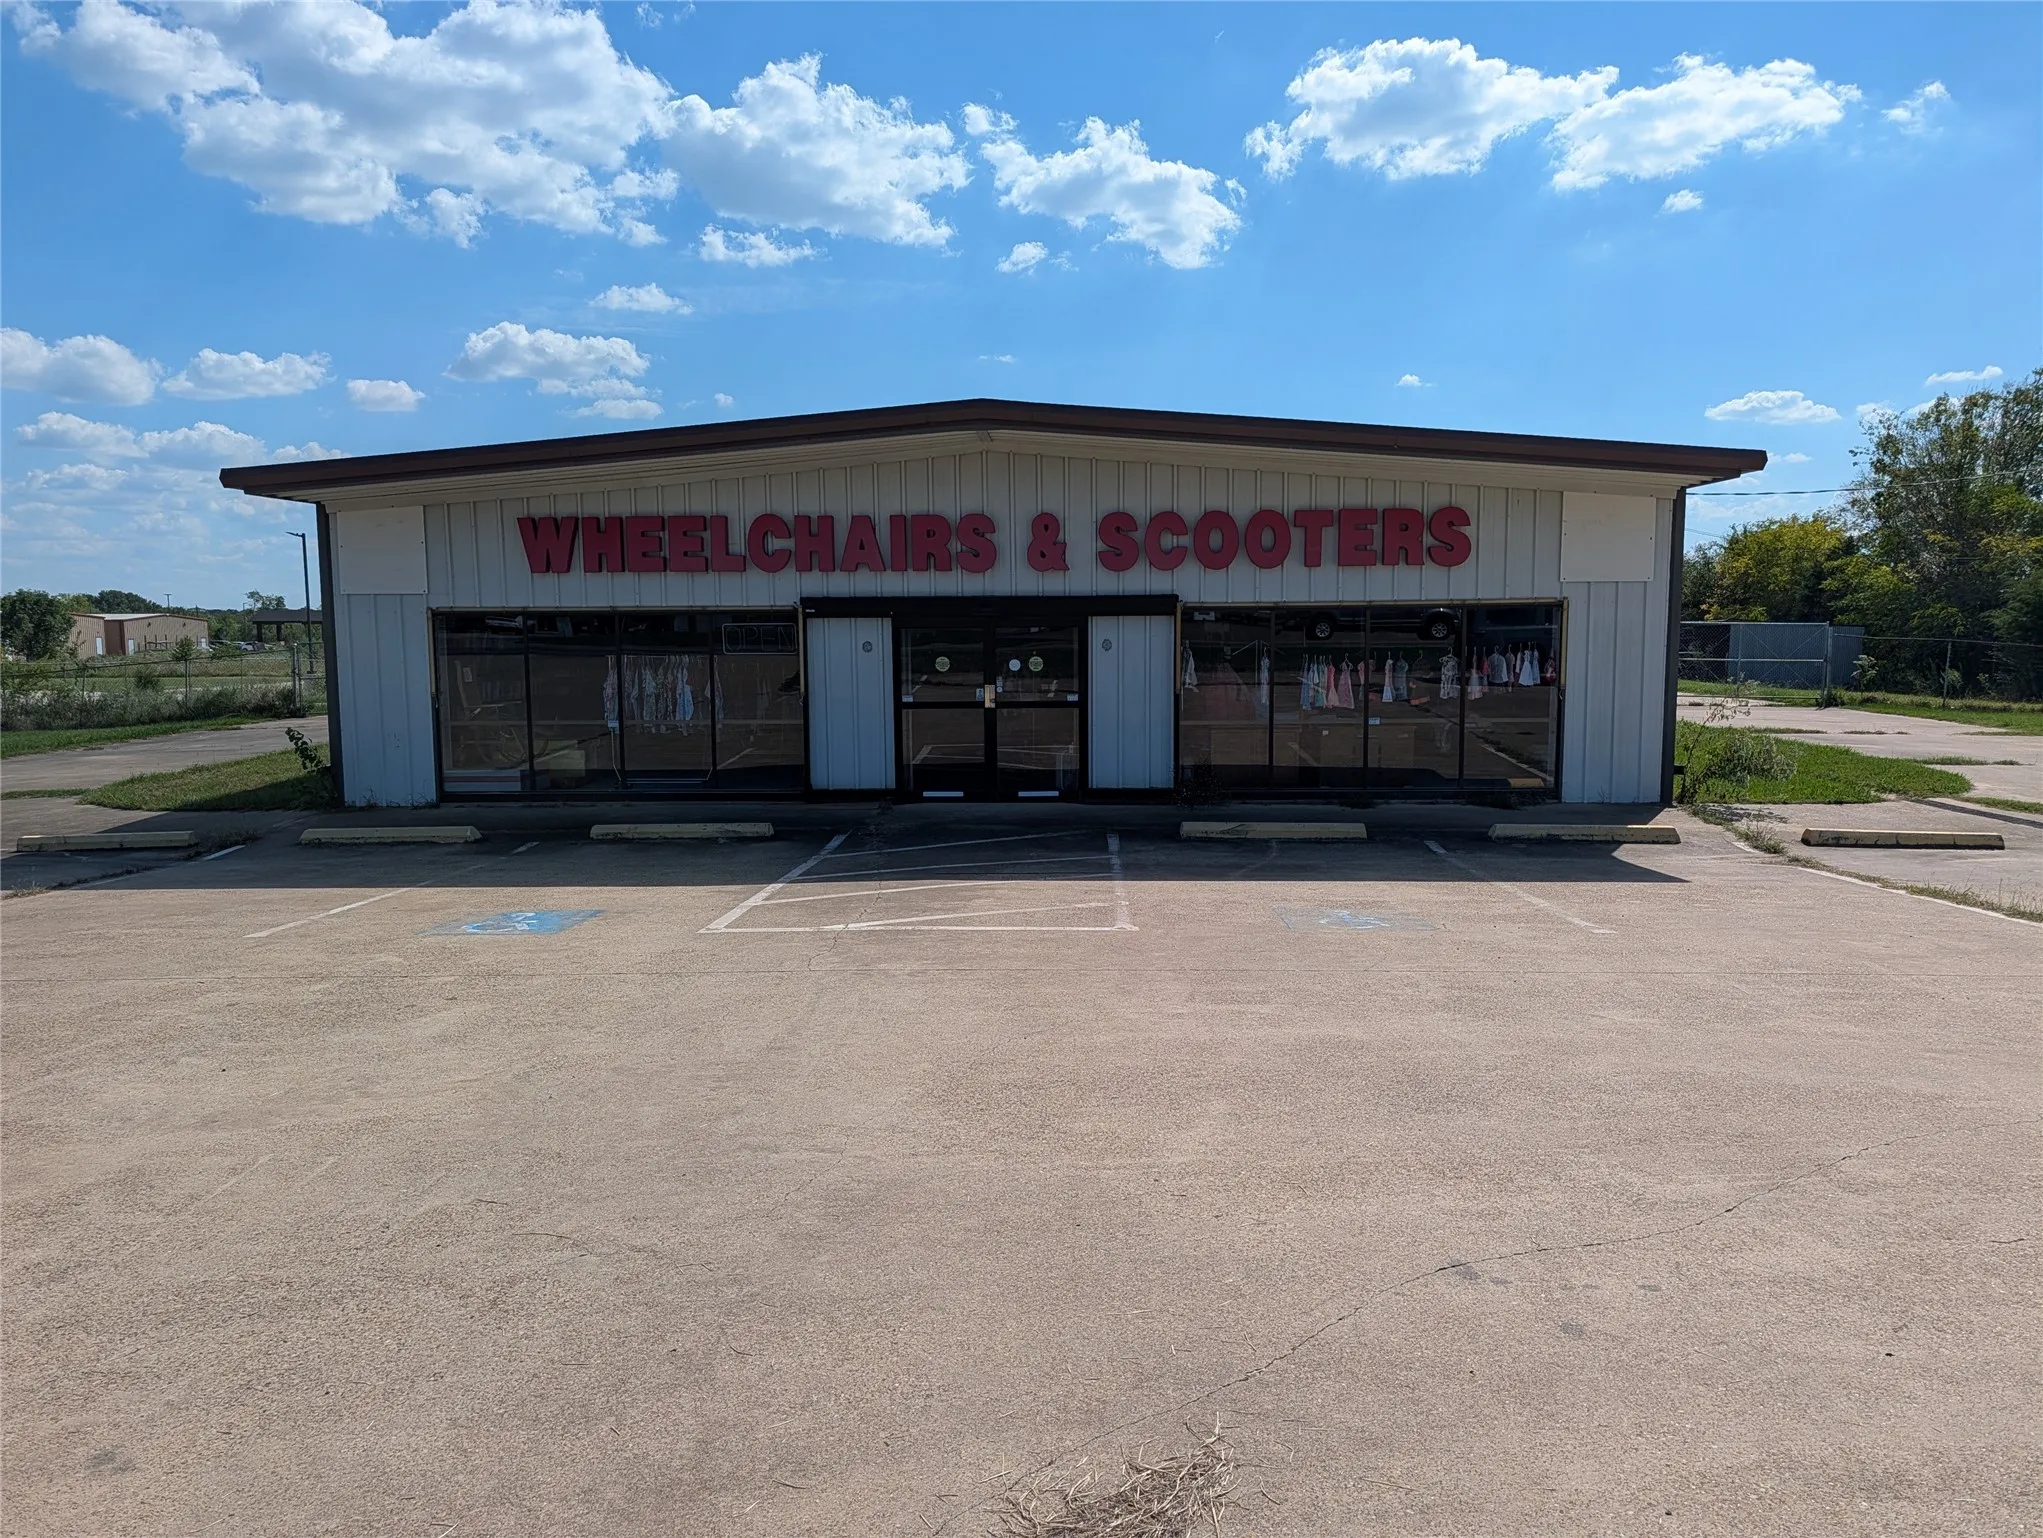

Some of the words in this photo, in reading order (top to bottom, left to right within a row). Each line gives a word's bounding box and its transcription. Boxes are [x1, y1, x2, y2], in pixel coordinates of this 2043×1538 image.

[517, 513, 998, 574] WHEELCHAIRS
[1026, 512, 1071, 573] &
[1097, 506, 1472, 572] SCOOTERS
[725, 625, 795, 652] OPEN
